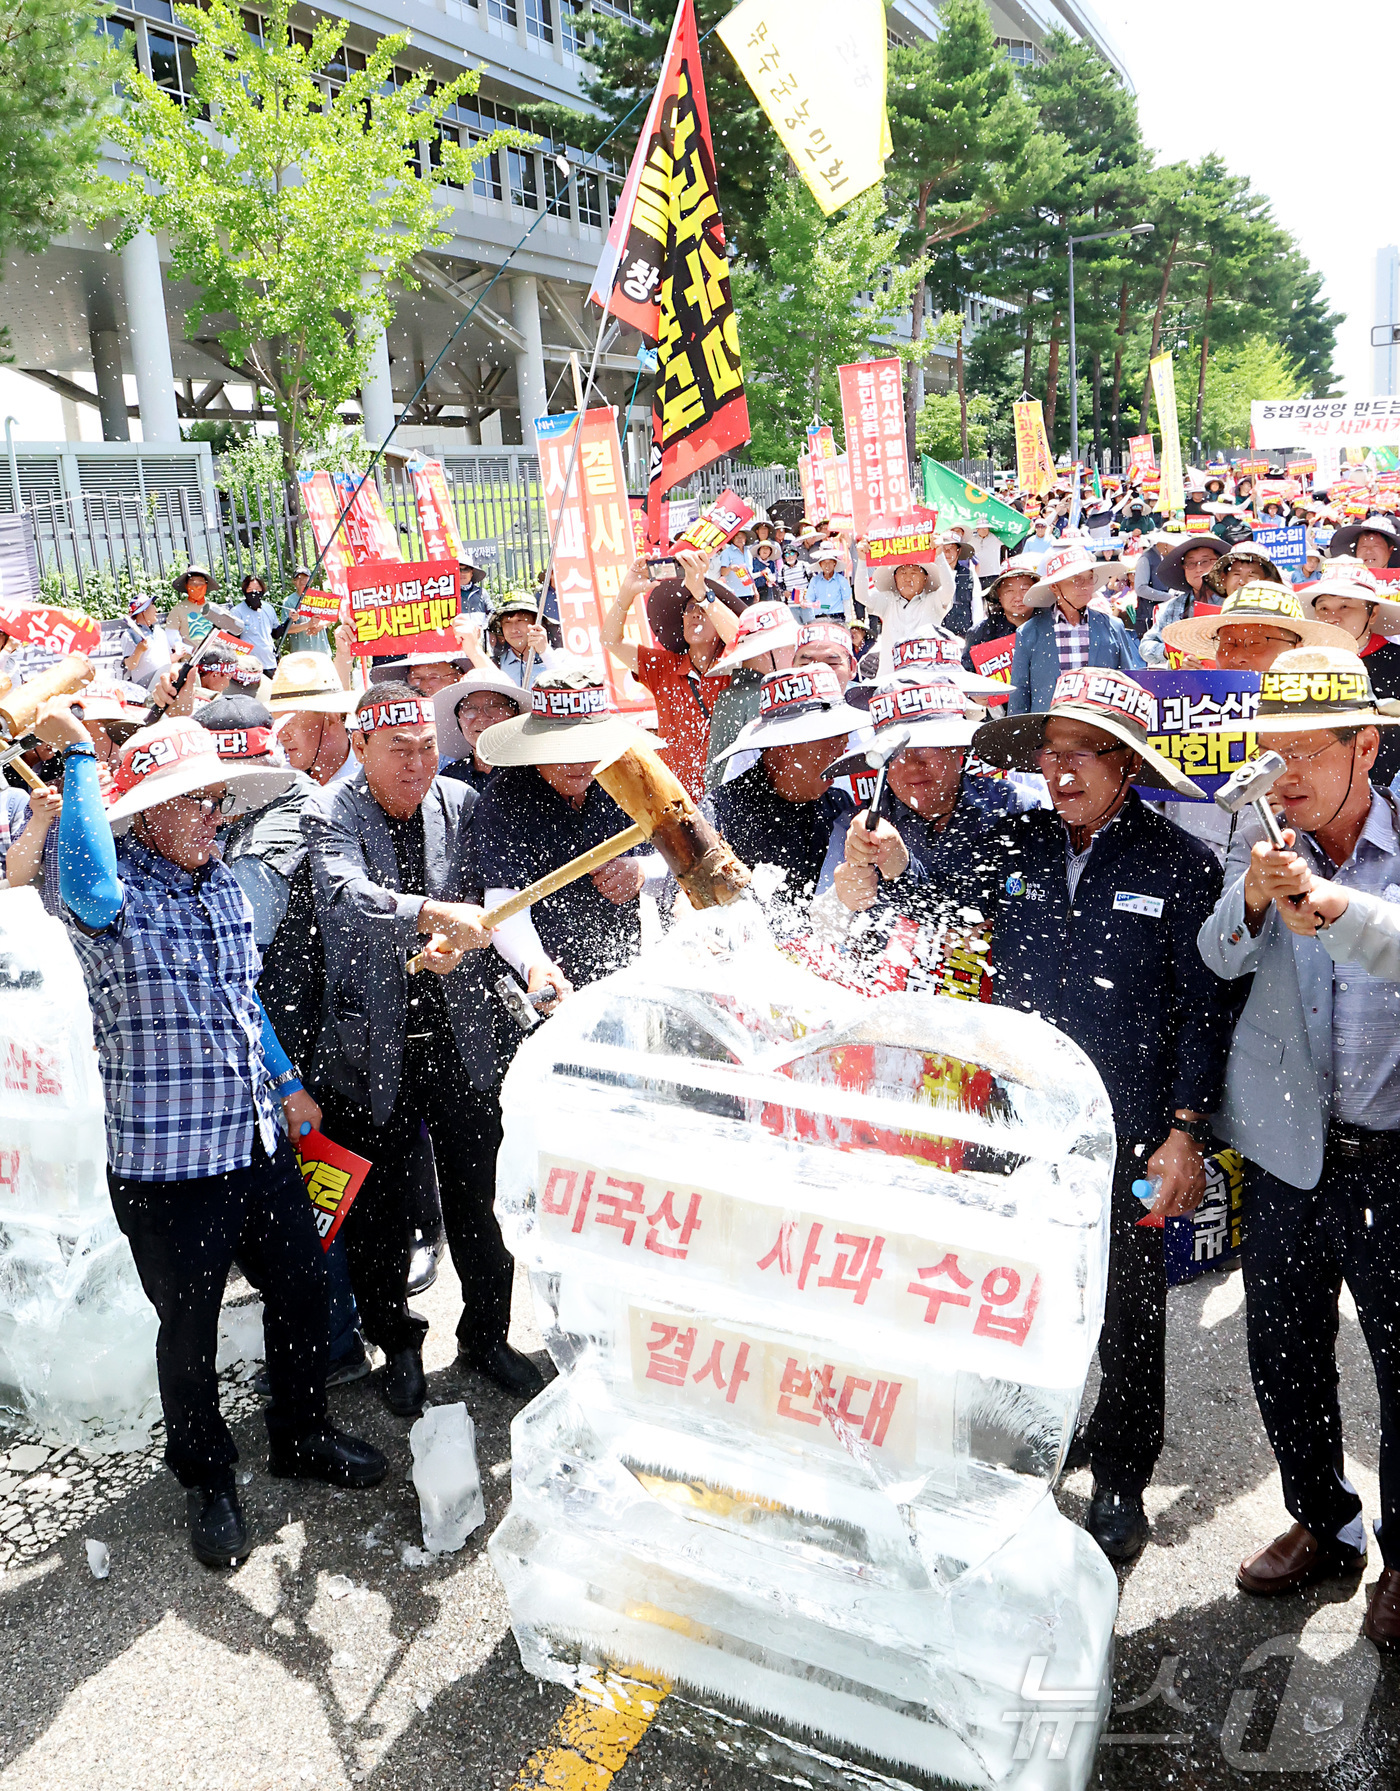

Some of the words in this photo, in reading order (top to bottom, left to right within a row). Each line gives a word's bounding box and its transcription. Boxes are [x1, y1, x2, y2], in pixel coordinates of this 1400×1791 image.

[1263, 403, 1347, 419] 농업희생양
[537, 419, 555, 431] NH
[1256, 528, 1303, 543] 사과수입!
[1268, 543, 1304, 560] 사반대!
[351, 584, 392, 610] 미국산
[394, 580, 423, 603] 사과
[424, 575, 455, 599] 수입
[354, 599, 457, 642] 결사반대!!
[904, 640, 938, 660] 사과
[979, 652, 1012, 676] 미국산
[532, 691, 548, 712] 과
[550, 690, 607, 714] 반대한
[774, 676, 813, 705] 사과
[1087, 677, 1152, 722] 반대한
[1261, 675, 1368, 702] 보장하라!
[377, 701, 420, 727] 사과
[871, 694, 895, 722] 과
[131, 736, 180, 775] 수입
[542, 1166, 702, 1260] 미국산
[757, 1208, 885, 1304] 사과
[907, 1253, 1042, 1347] 수입
[646, 1321, 751, 1405] 결사
[776, 1356, 903, 1447] 반대
